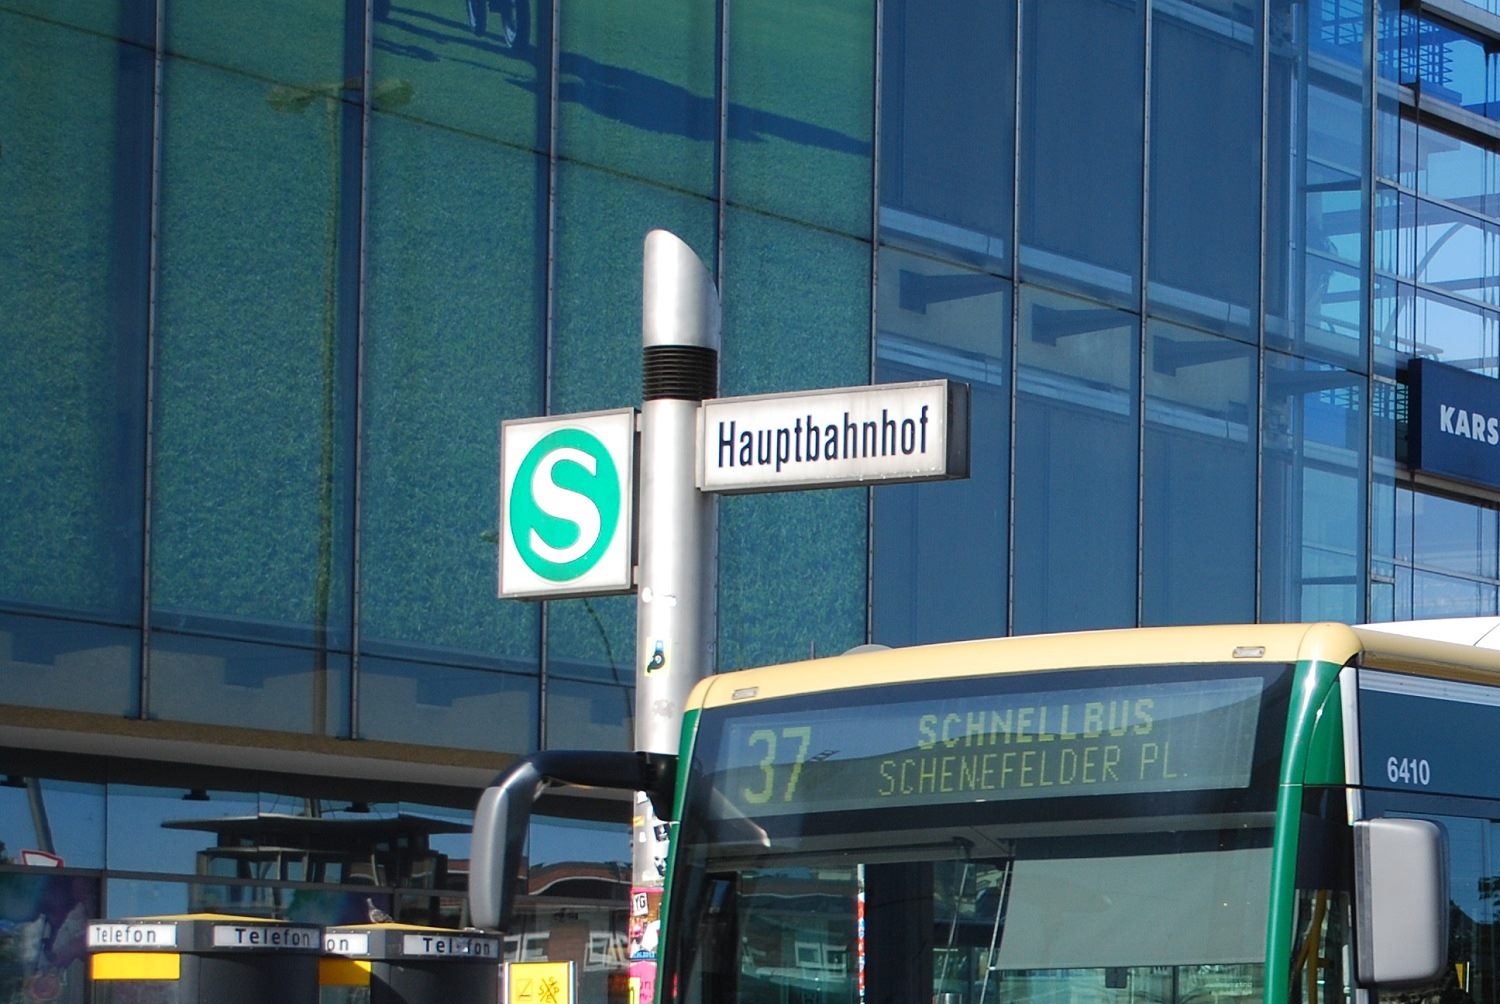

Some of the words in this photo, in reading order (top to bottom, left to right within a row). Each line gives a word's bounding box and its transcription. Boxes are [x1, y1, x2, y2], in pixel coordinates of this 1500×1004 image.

[718, 405, 929, 472] Hauptbahnhof
[530, 446, 601, 565] S
[918, 698, 1156, 751] SCHNELLBUS
[743, 726, 812, 805] 37
[879, 745, 1121, 796] SCHENEFELDER
[1387, 756, 1430, 785] 6410
[96, 927, 157, 943] Telefon
[235, 928, 310, 946] Telefon
[423, 937, 490, 955] Telfon
